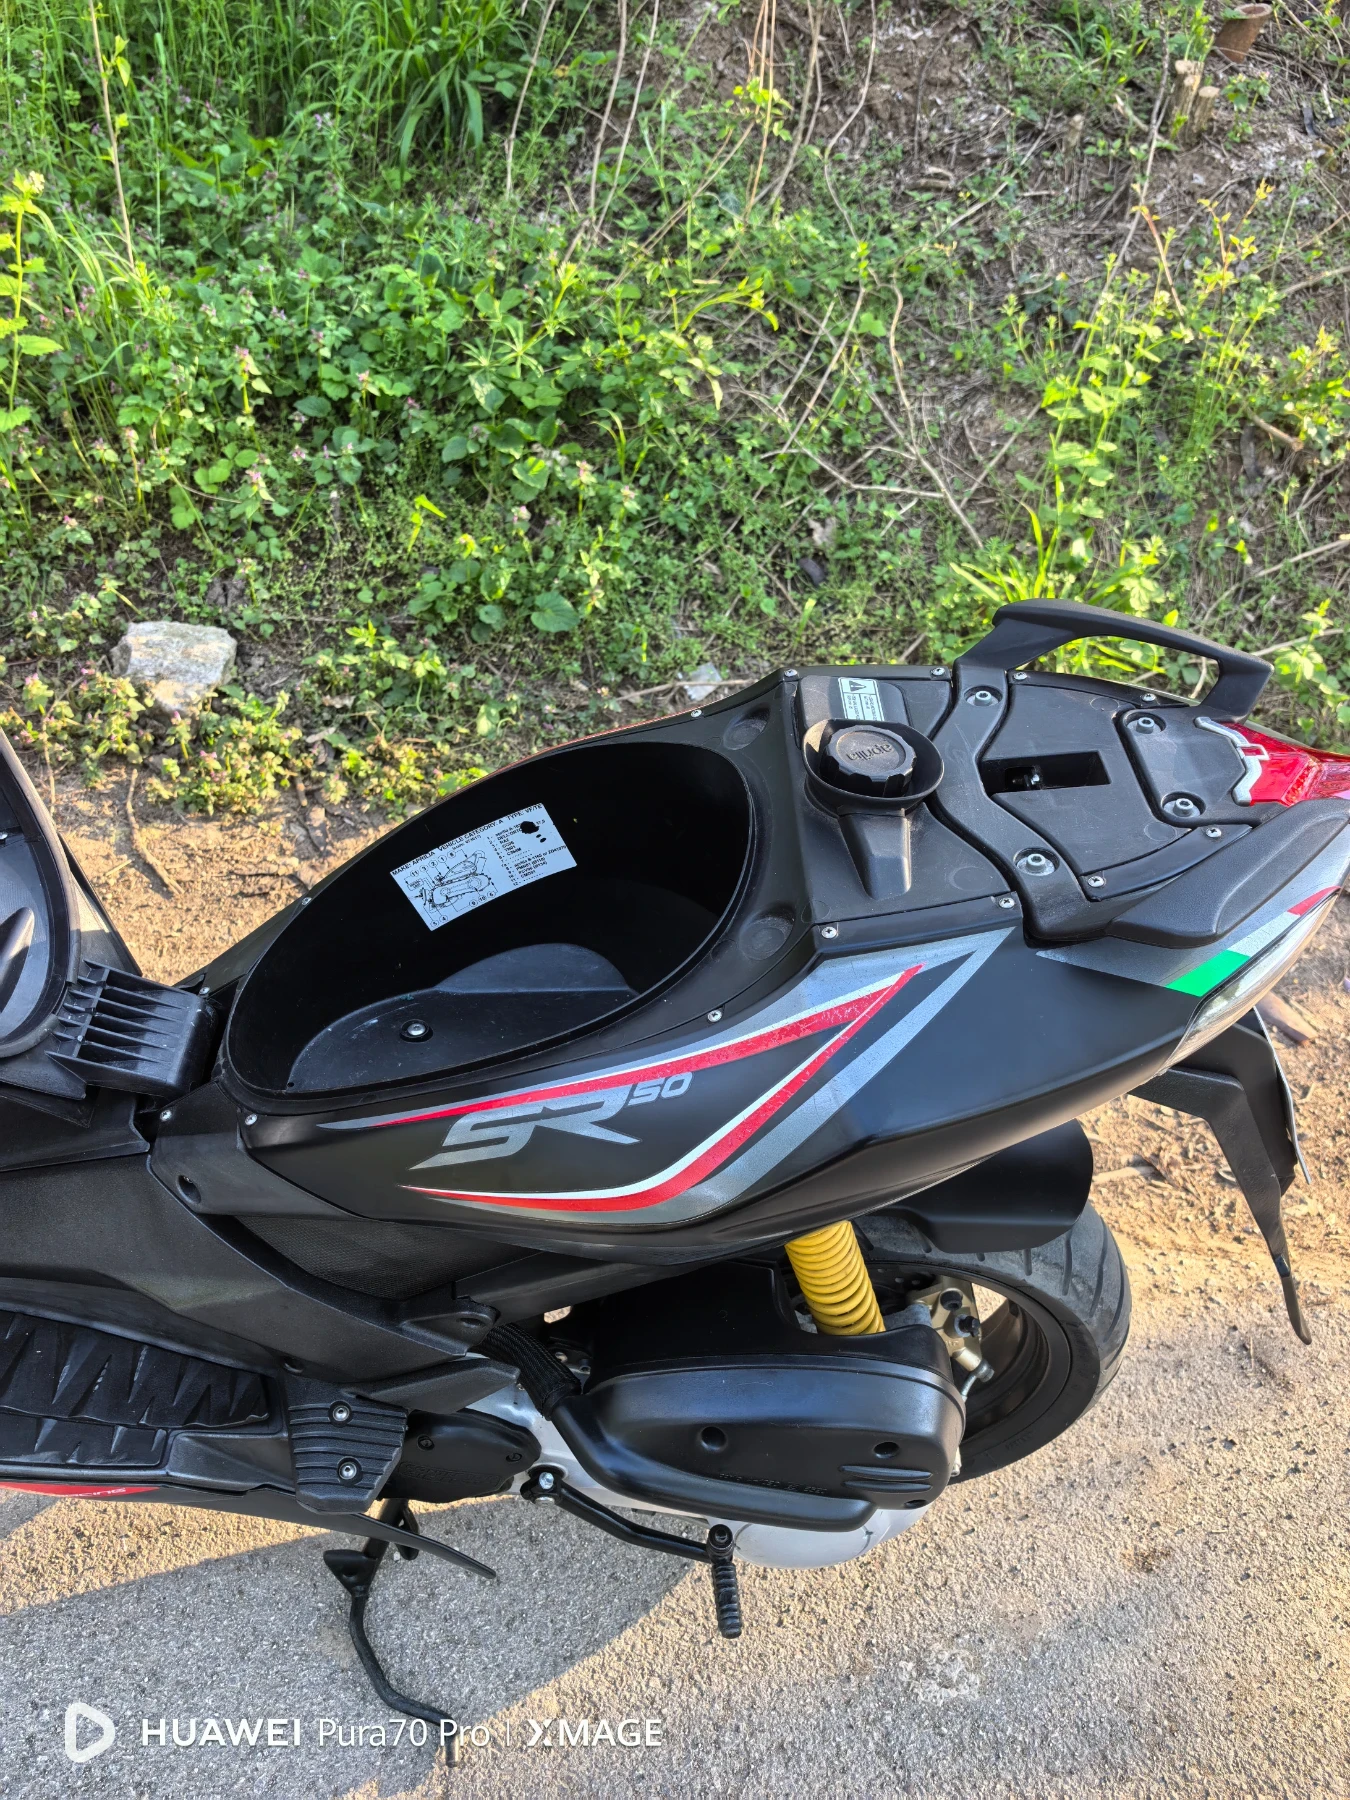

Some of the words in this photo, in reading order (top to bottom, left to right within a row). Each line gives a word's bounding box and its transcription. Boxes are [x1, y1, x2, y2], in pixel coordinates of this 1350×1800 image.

[845, 743, 892, 761] aprilia
[391, 863, 411, 876] MAKE:
[412, 850, 435, 866] APRILIA
[438, 835, 464, 852] VEHICLE
